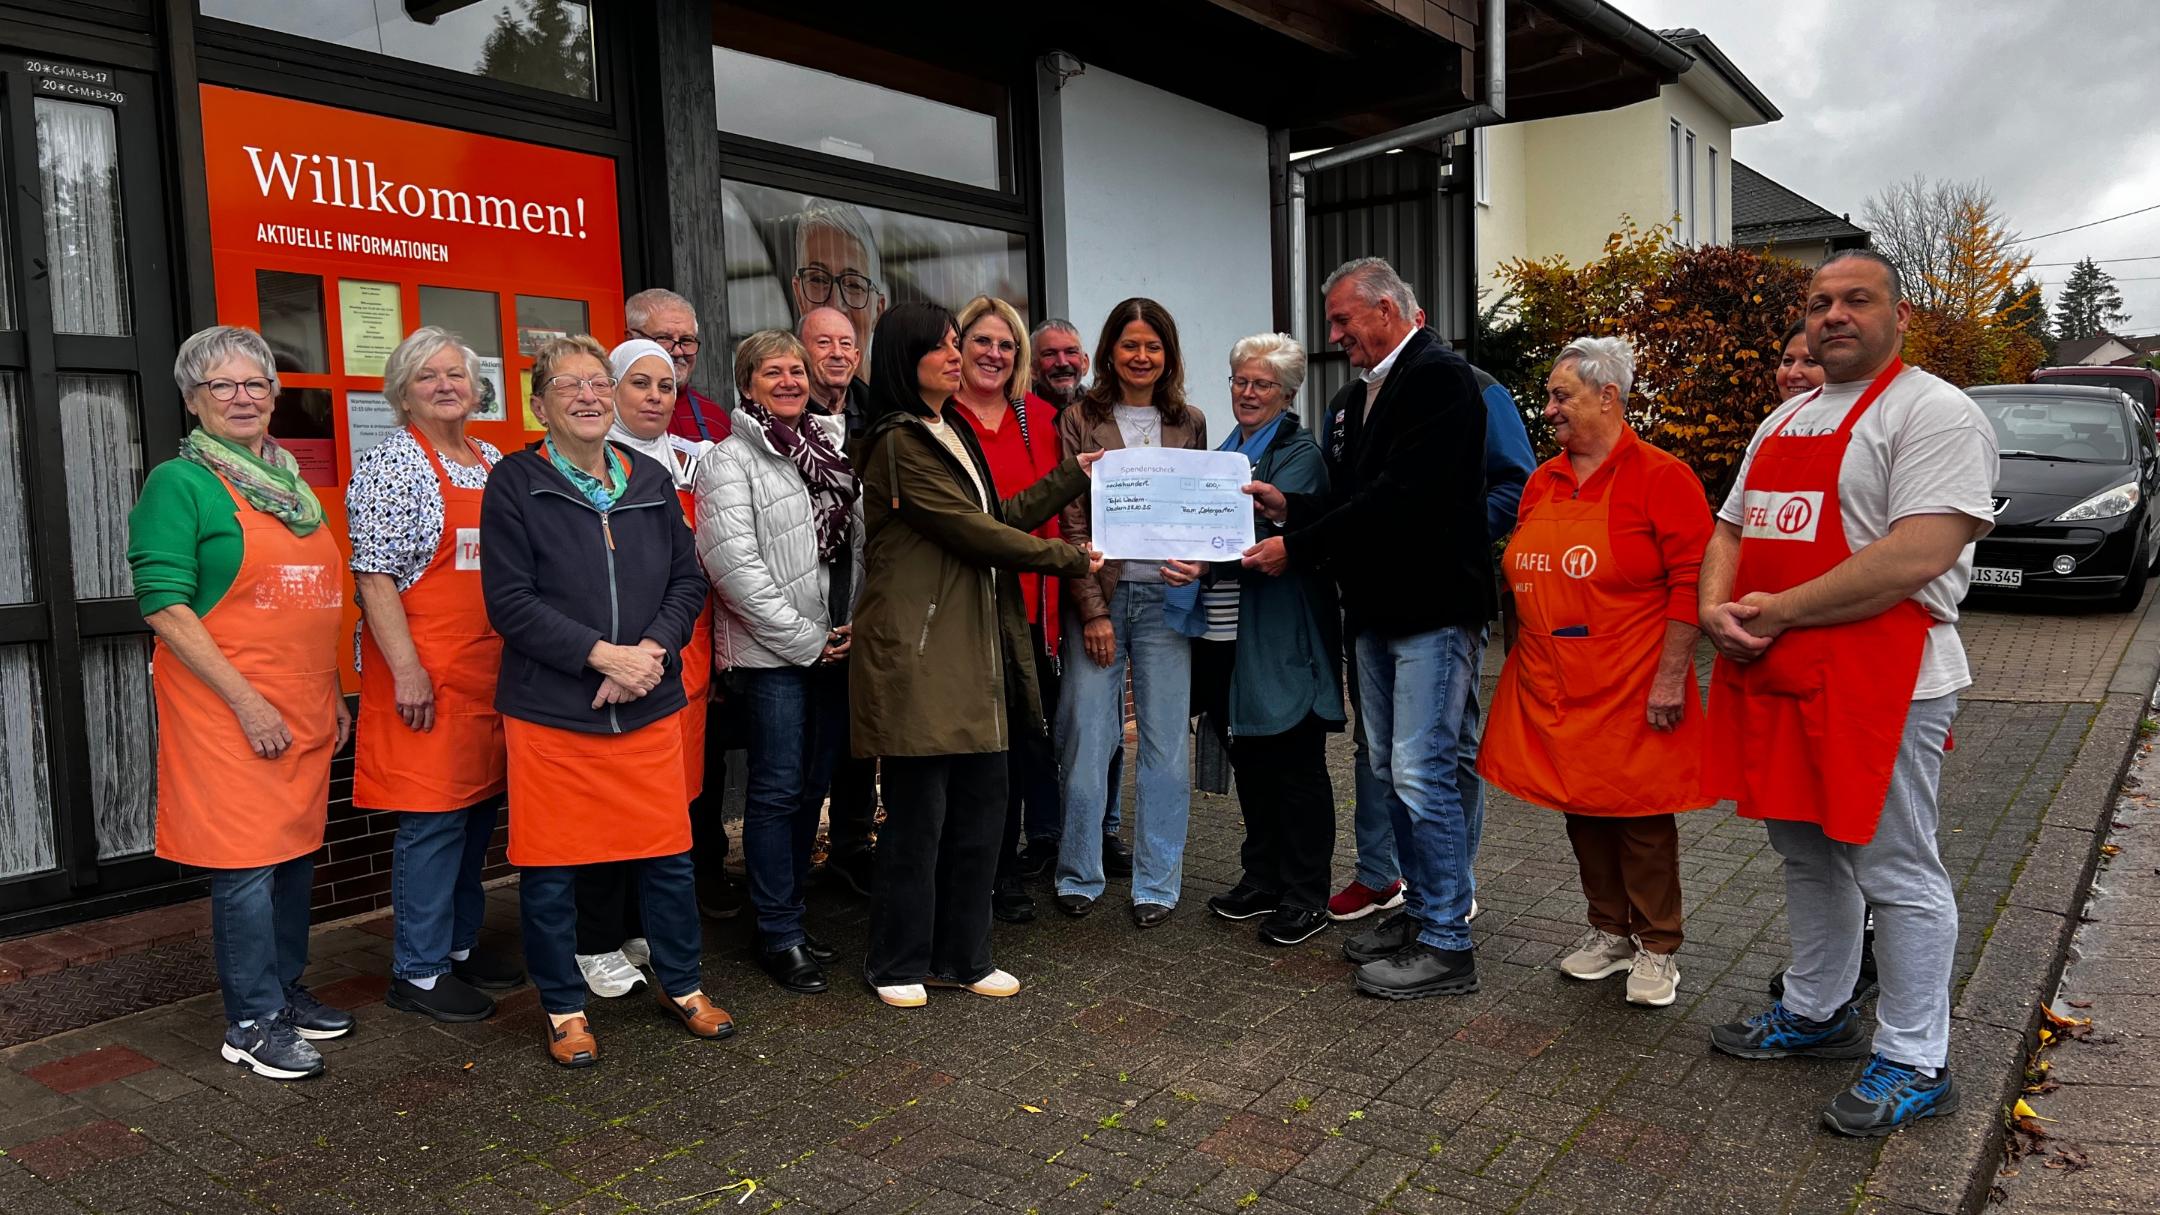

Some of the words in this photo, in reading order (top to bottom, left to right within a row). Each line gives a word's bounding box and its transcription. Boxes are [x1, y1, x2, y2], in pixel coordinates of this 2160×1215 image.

[243, 146, 586, 239] Willkommen!
[257, 222, 333, 250] AKTUELLE
[337, 232, 449, 262] INFORMATIONEN
[1515, 552, 1552, 572] TAFEL
[1976, 569, 1991, 581] IS
[1995, 570, 2020, 583] 345
